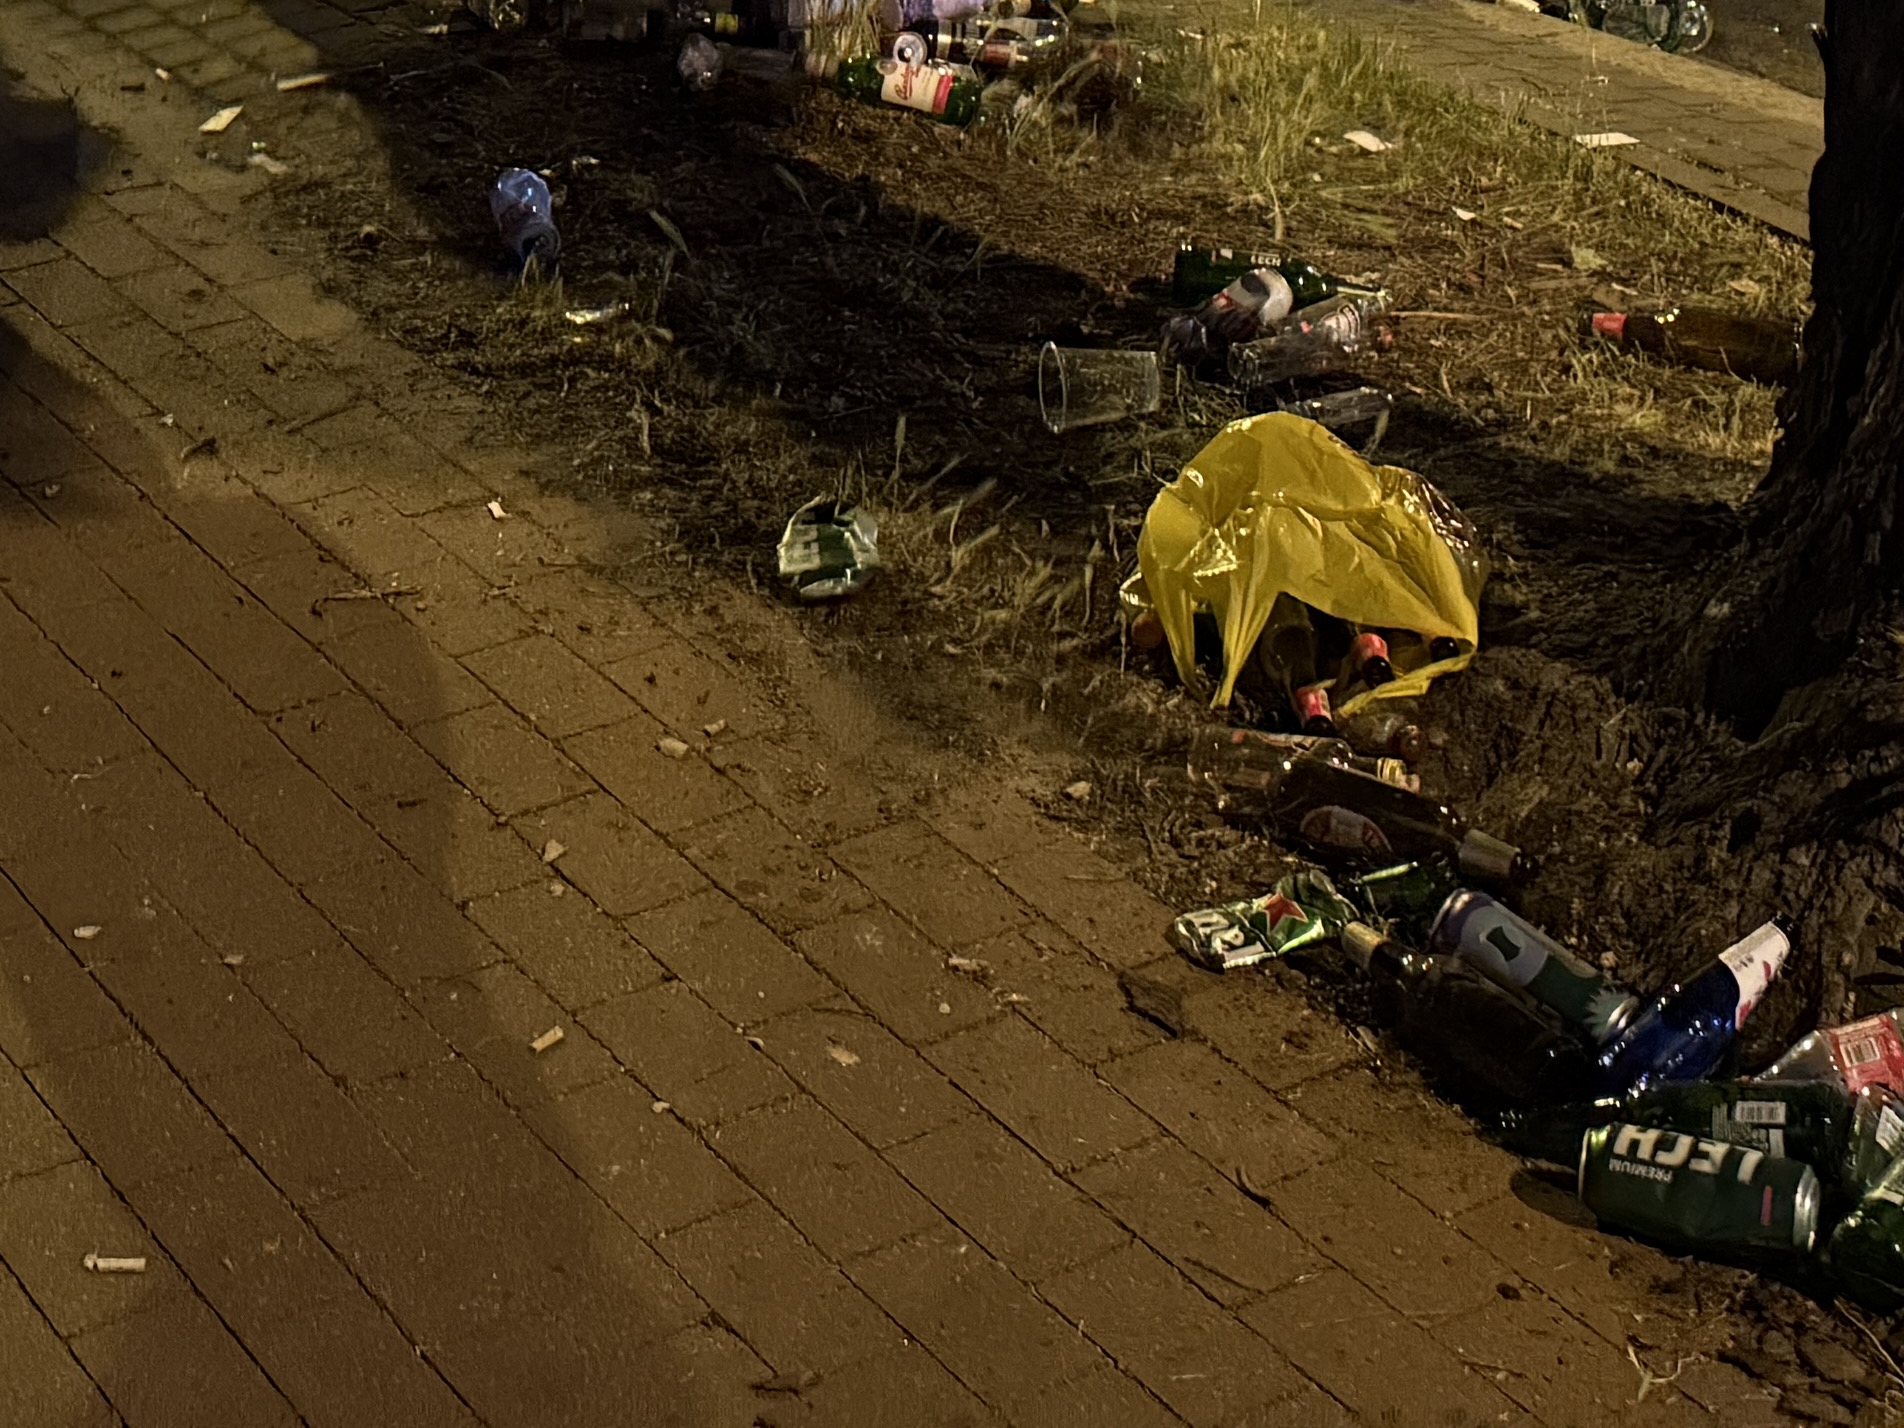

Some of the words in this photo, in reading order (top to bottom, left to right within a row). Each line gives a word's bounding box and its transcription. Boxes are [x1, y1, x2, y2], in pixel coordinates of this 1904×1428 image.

[1250, 255, 1281, 267] LECH
[1613, 1123, 1763, 1185] LECH
[1608, 1158, 1673, 1184] PREMIUM
